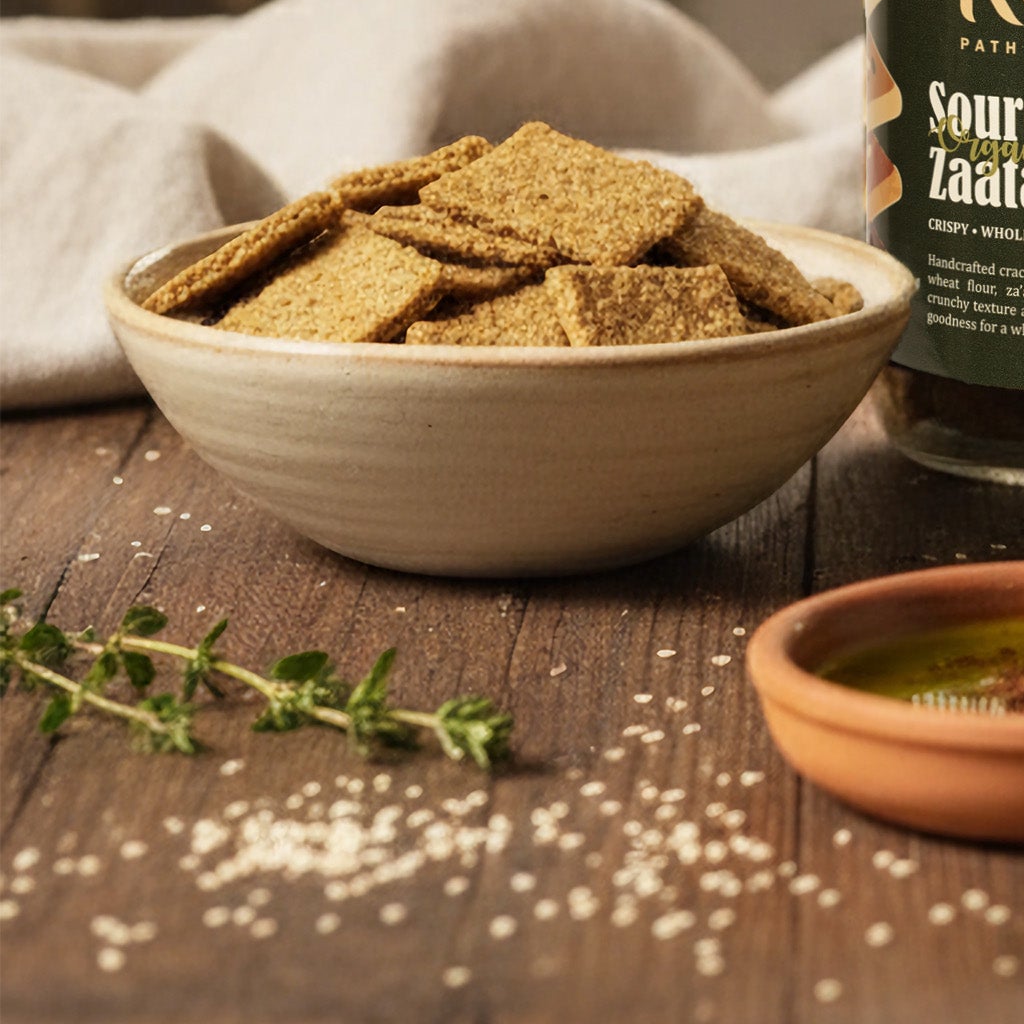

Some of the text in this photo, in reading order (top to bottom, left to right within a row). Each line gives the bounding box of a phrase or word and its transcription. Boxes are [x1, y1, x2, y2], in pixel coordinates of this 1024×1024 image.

[960, 37, 1017, 55] PATH
[928, 217, 969, 236] CRISPY
[927, 253, 996, 276] Handcrafted
[927, 273, 960, 290] wheat
[966, 278, 998, 297] flour,
[926, 293, 970, 313] crunchy
[973, 299, 1017, 316] texture
[926, 311, 977, 331] goodness
[979, 319, 998, 334] for
[1000, 323, 1008, 335] a
